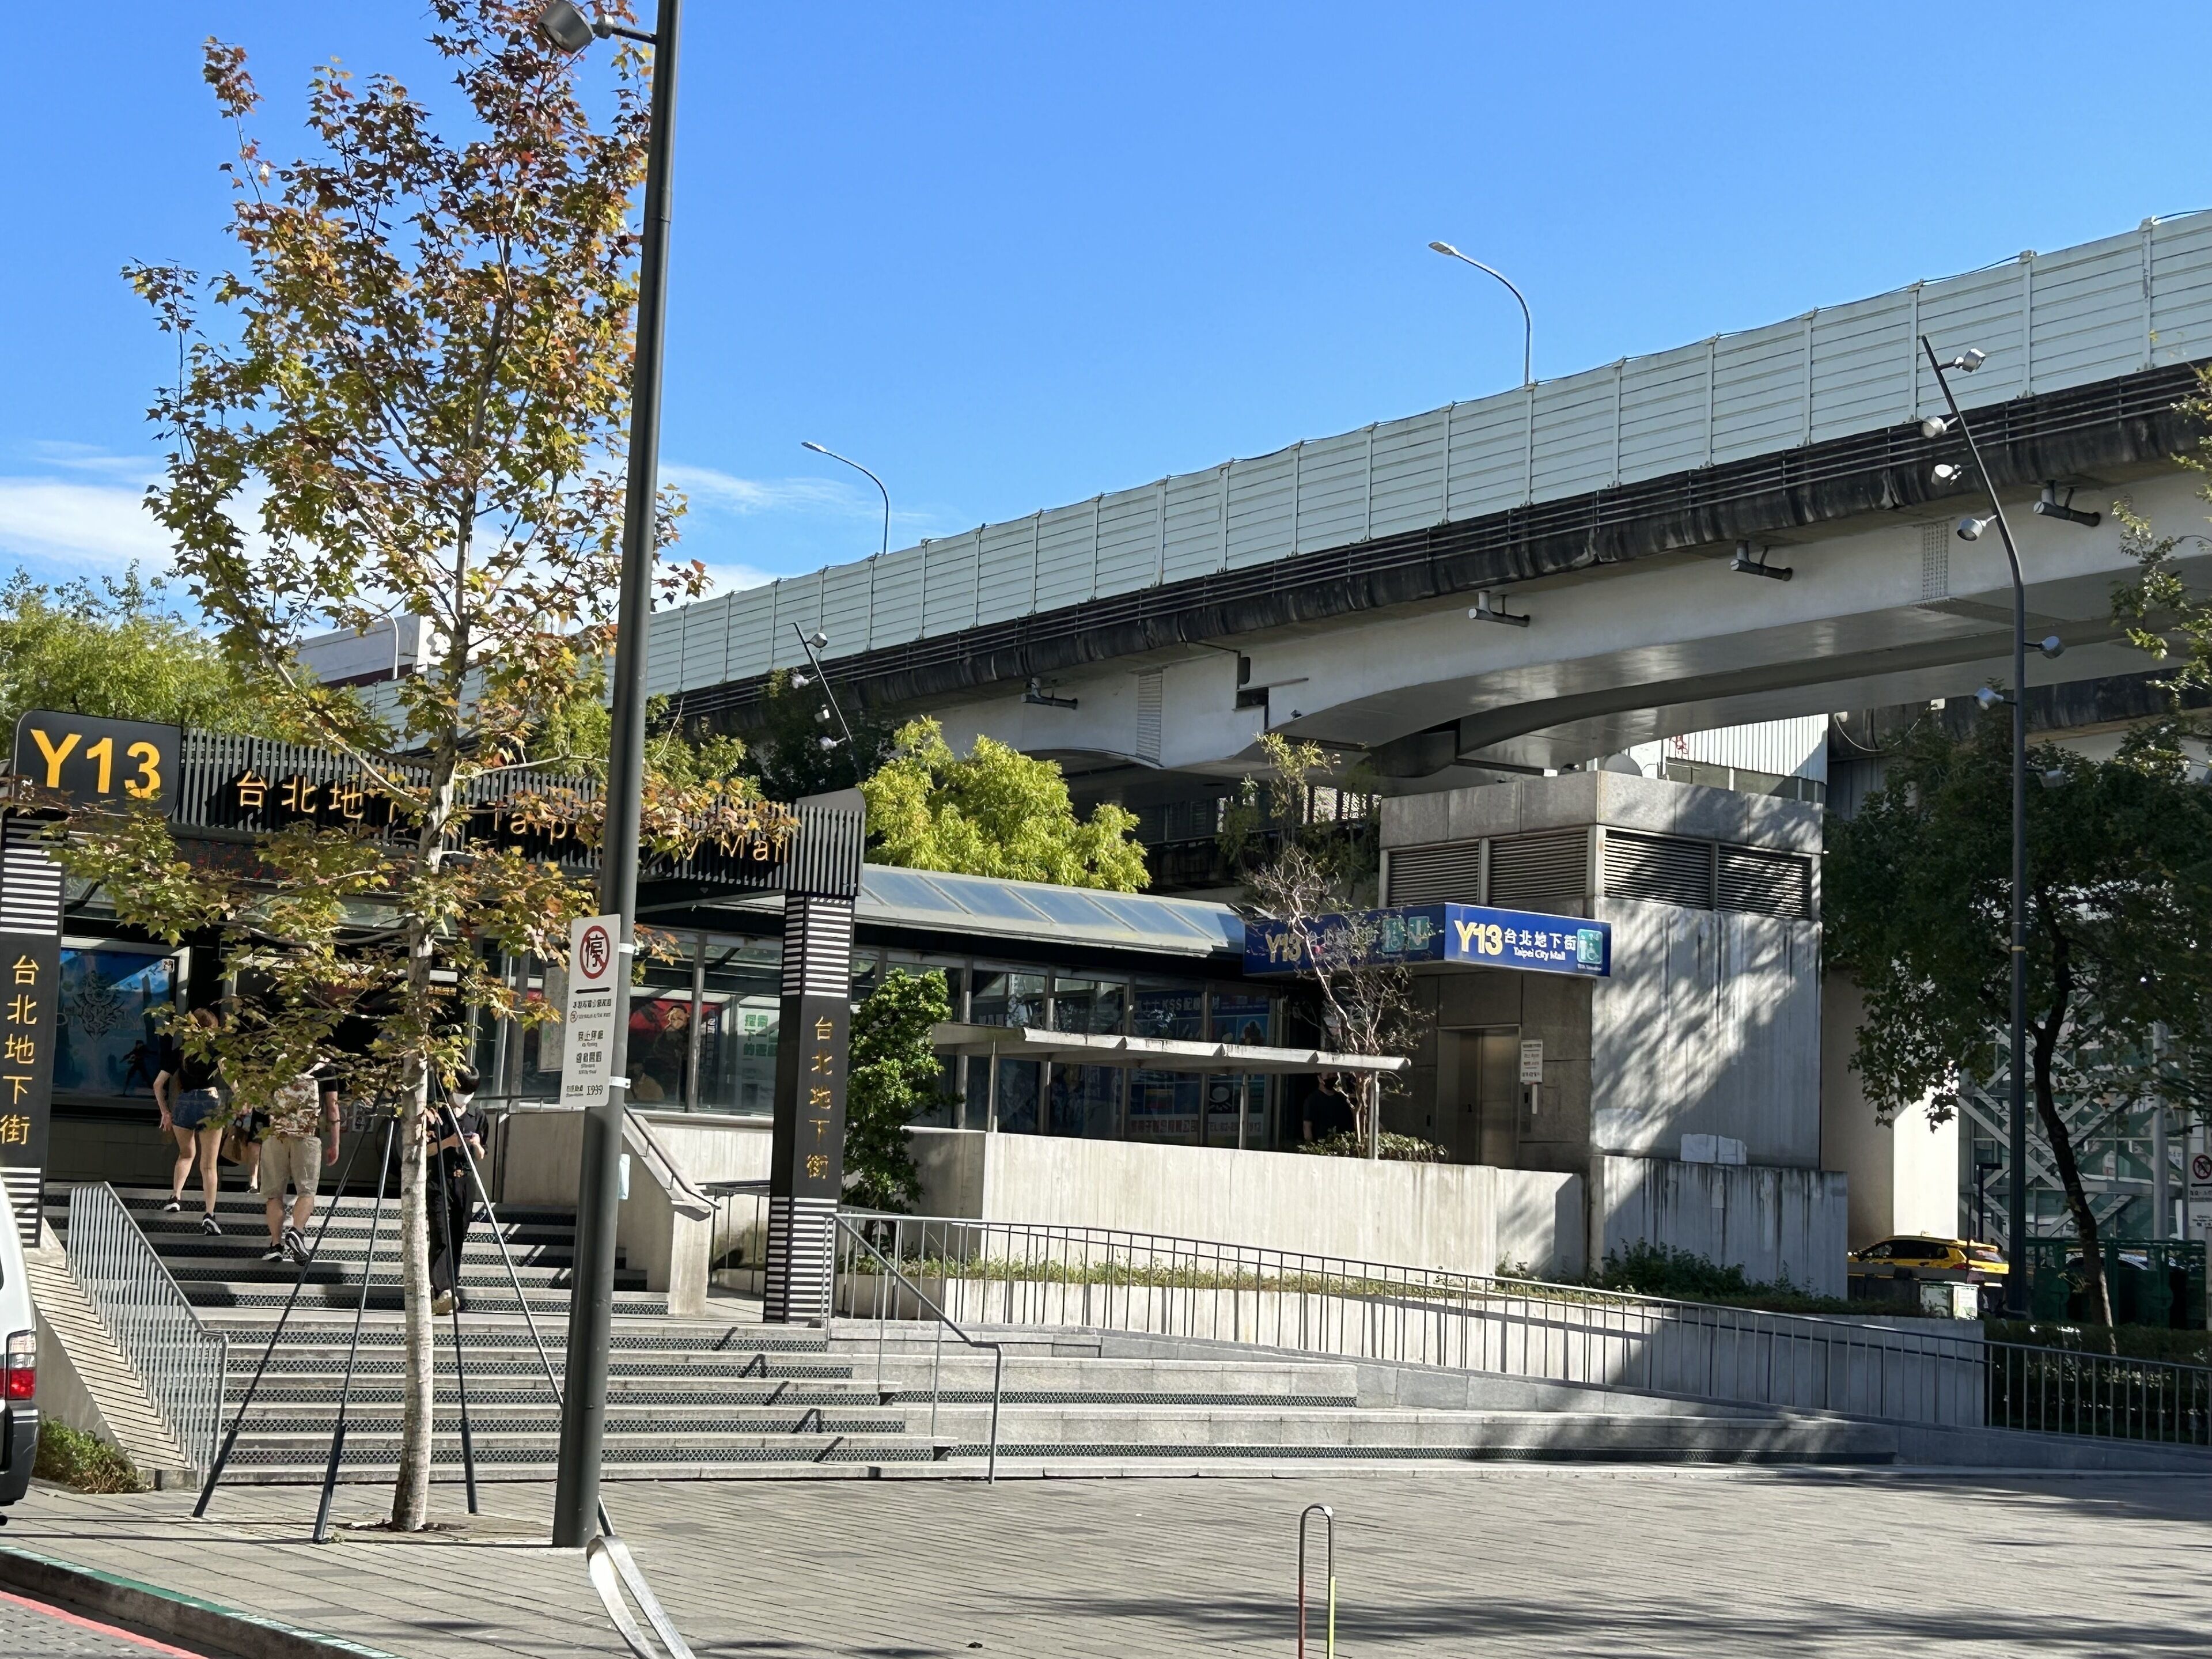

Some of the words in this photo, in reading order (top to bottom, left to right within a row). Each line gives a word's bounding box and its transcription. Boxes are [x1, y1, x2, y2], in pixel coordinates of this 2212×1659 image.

[30, 728, 161, 798] Y13
[585, 934, 605, 968] 停
[1265, 931, 1302, 963] Y13
[1454, 920, 1503, 956] Y13
[1504, 928, 1577, 951] 台北地下街
[1514, 946, 1534, 959] Taipei
[1535, 949, 1549, 961] City
[1550, 950, 1566, 960] Mall
[0, 955, 39, 1146] 台北地下街
[806, 1016, 834, 1180] 台北地下街
